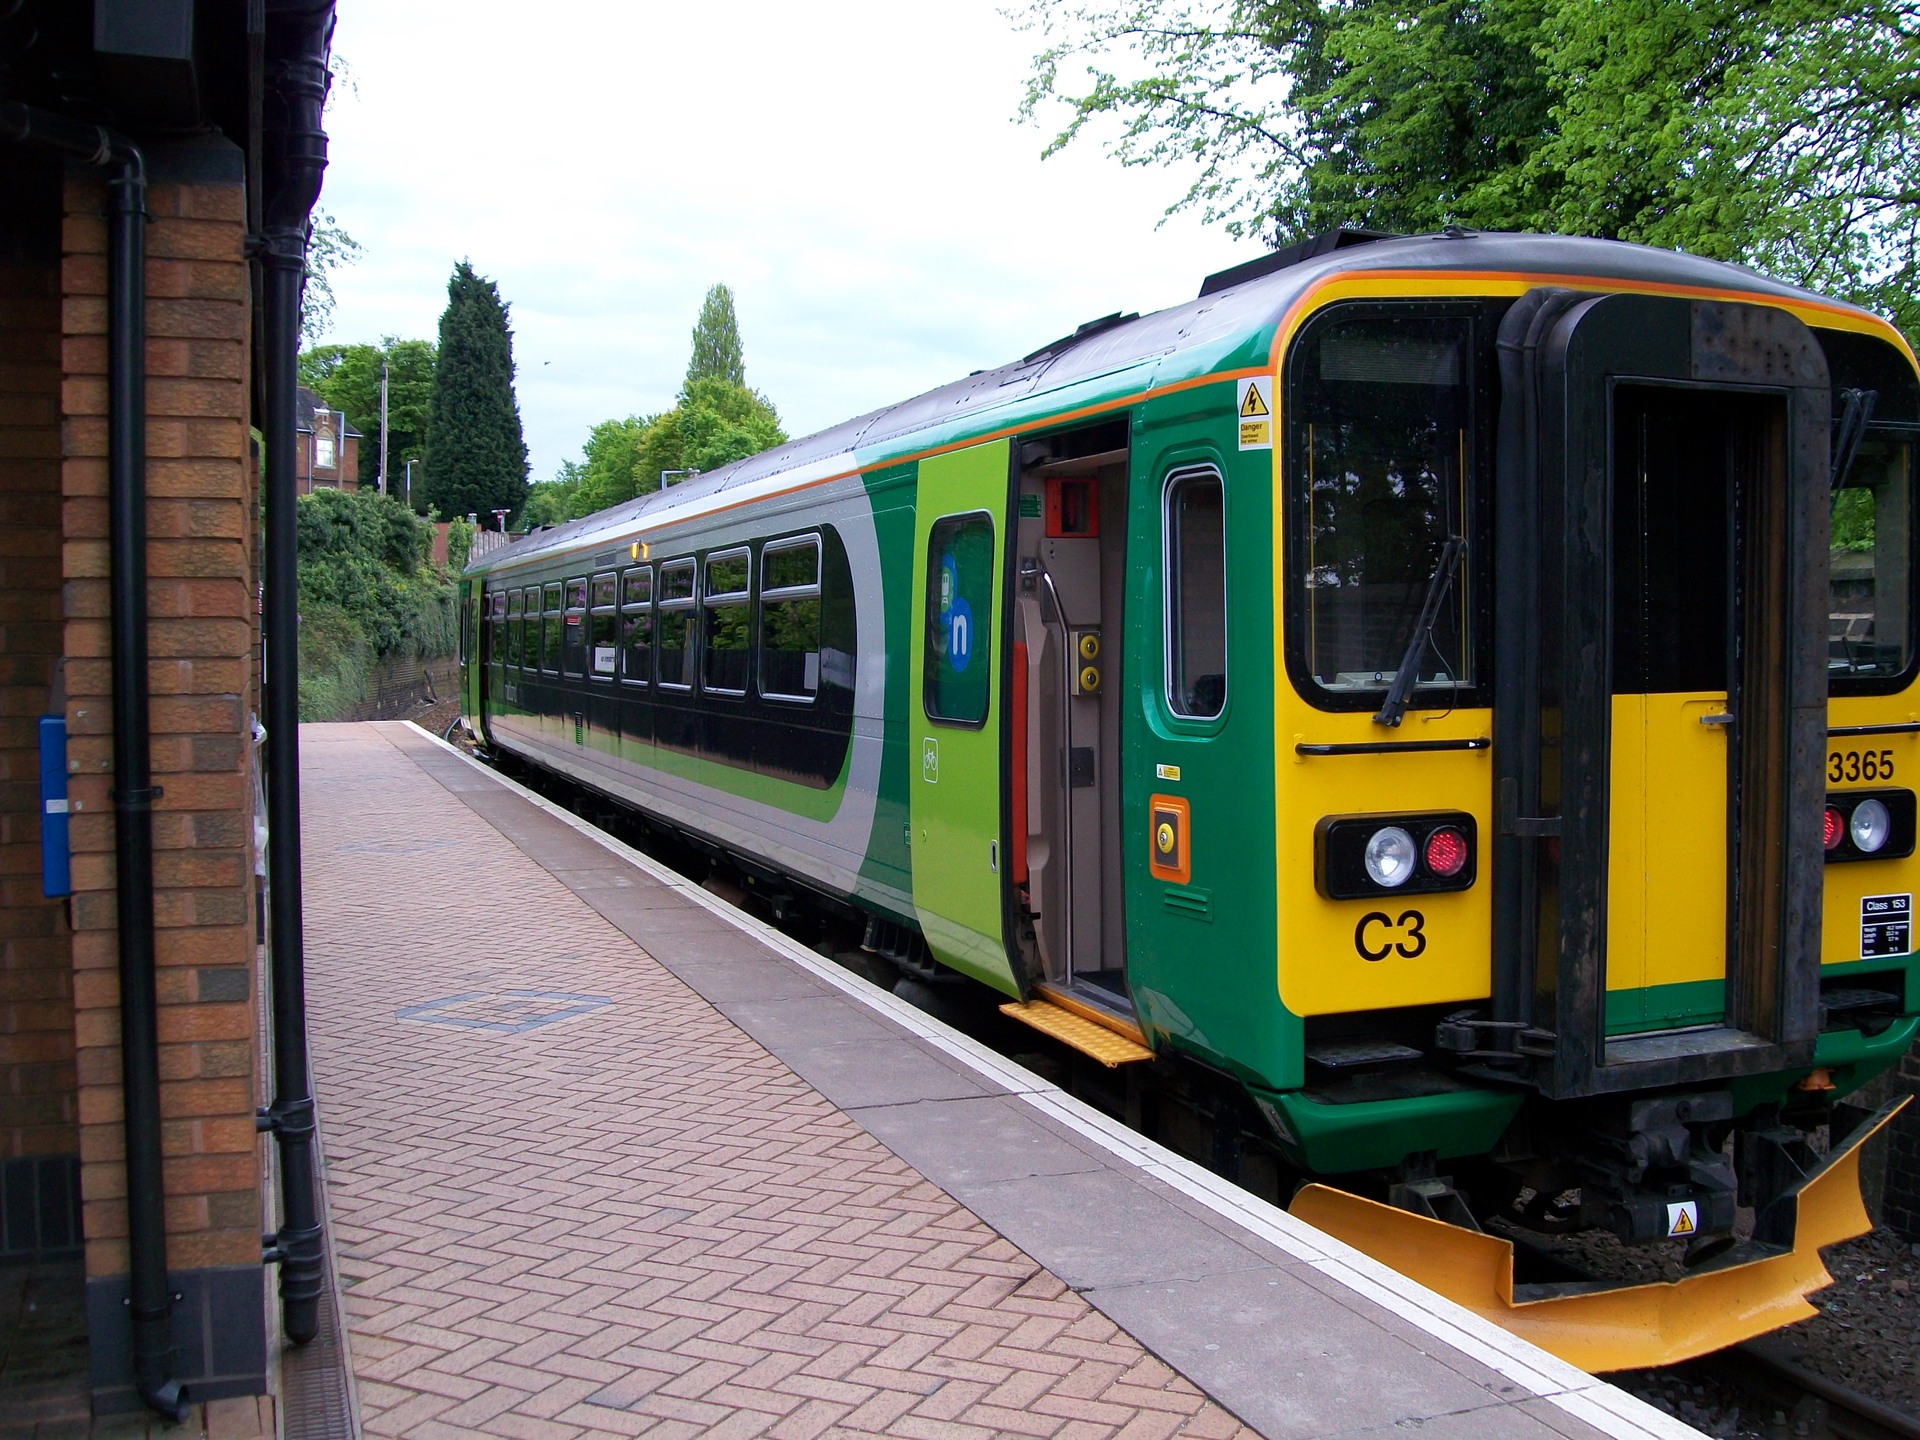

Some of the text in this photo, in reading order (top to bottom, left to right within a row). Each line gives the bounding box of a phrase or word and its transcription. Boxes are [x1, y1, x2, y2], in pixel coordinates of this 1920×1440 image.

[1241, 423, 1263, 432] Danger
[1828, 749, 1895, 783] 3365
[1866, 899, 1906, 911] Class 153
[1354, 909, 1427, 963] C3
